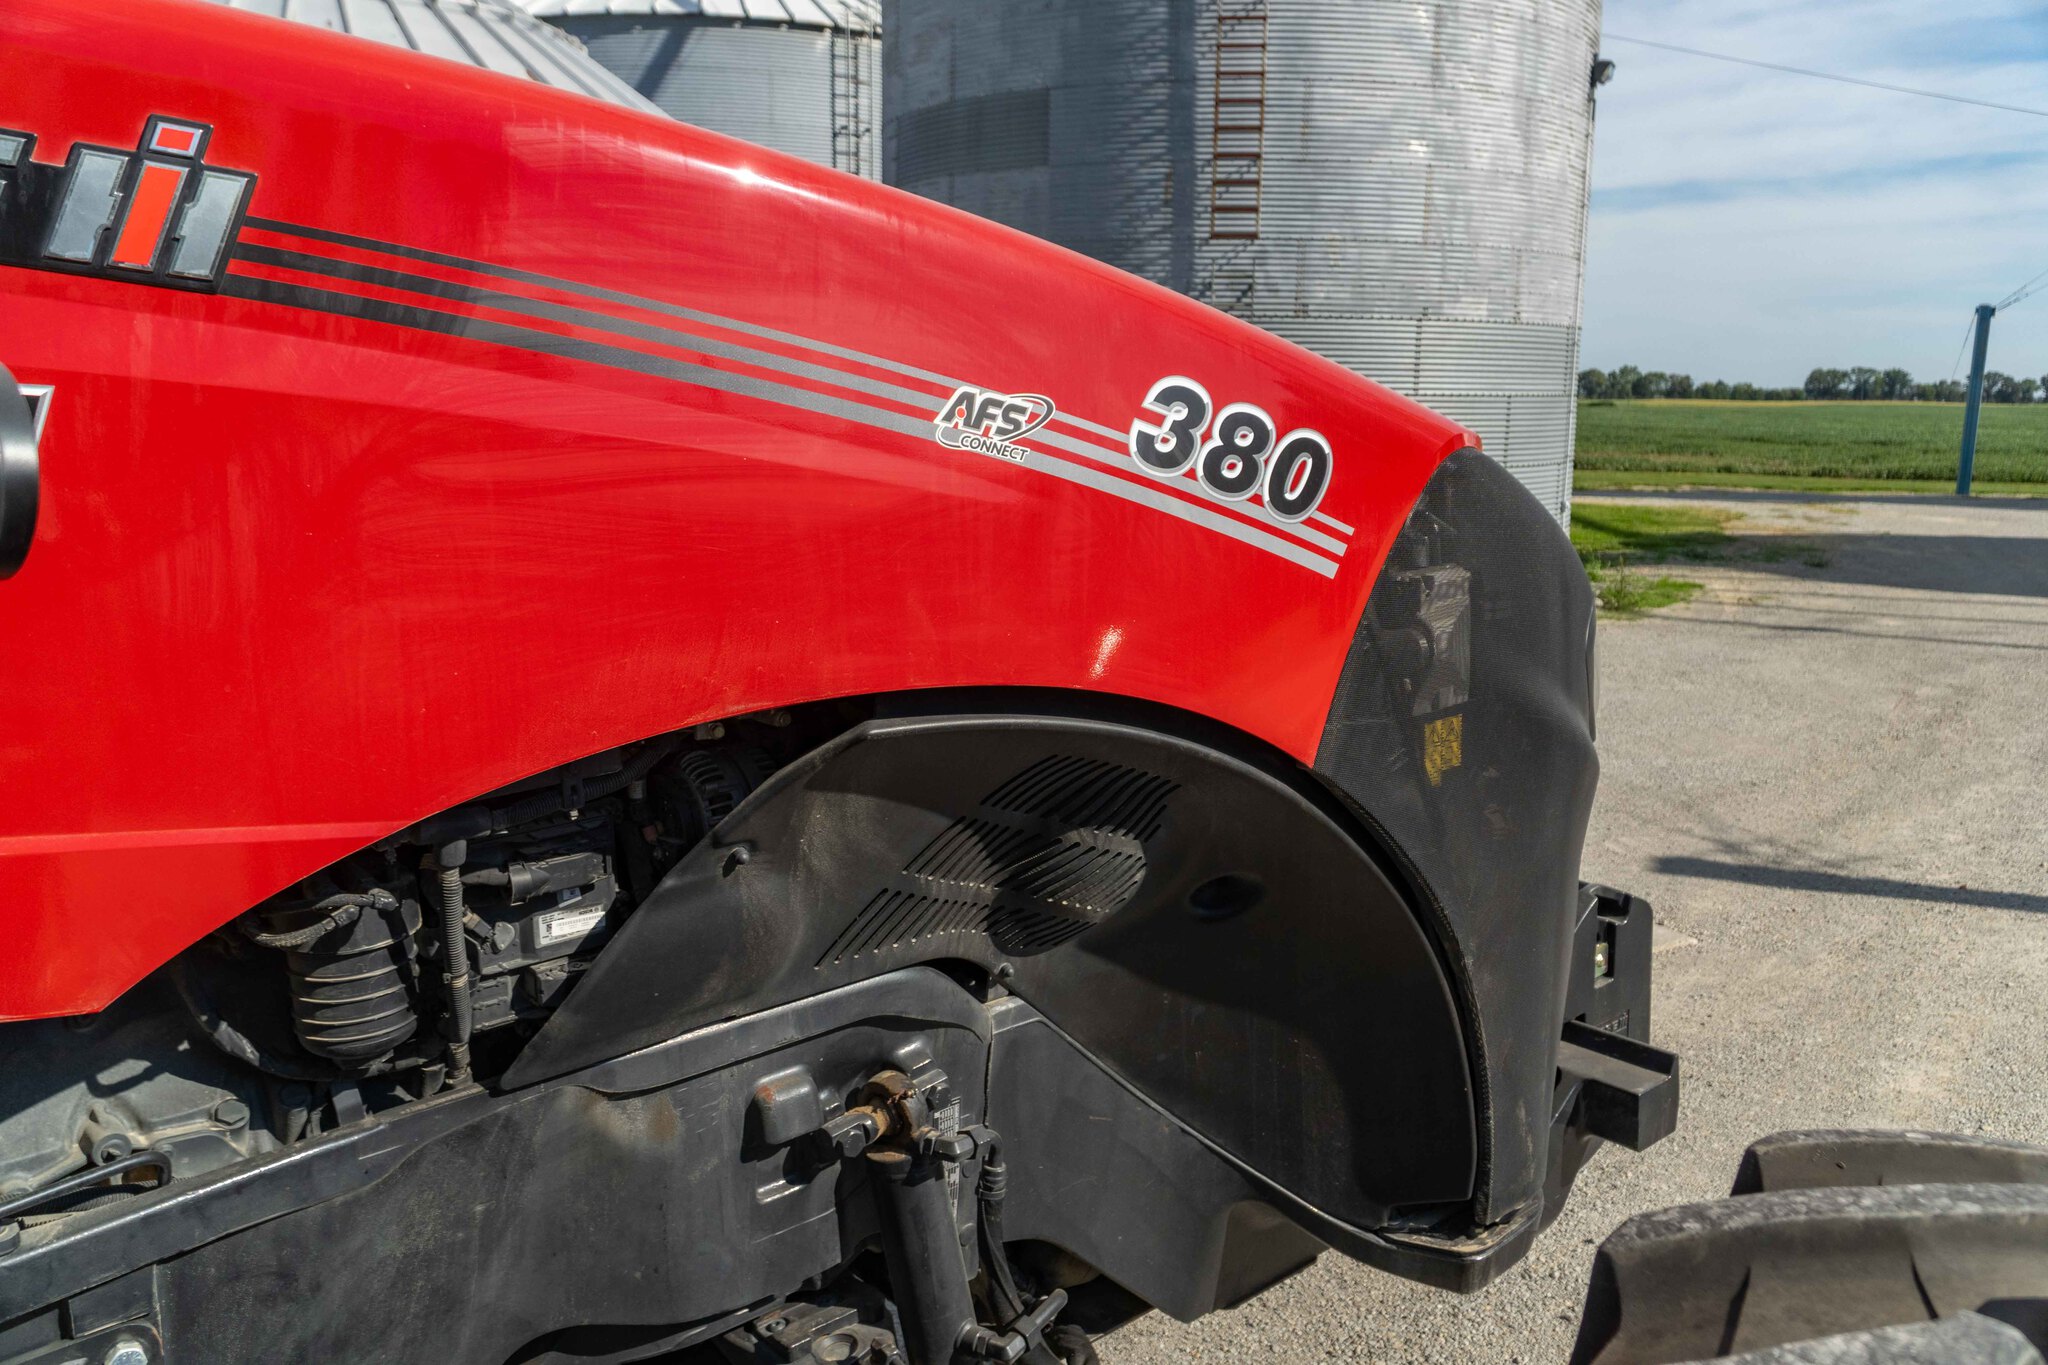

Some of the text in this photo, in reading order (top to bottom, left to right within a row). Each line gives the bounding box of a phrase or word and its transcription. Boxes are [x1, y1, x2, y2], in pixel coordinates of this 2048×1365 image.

[938, 387, 1030, 437] AFS
[960, 435, 1029, 461] CONNECT
[1130, 376, 1332, 523] 380
